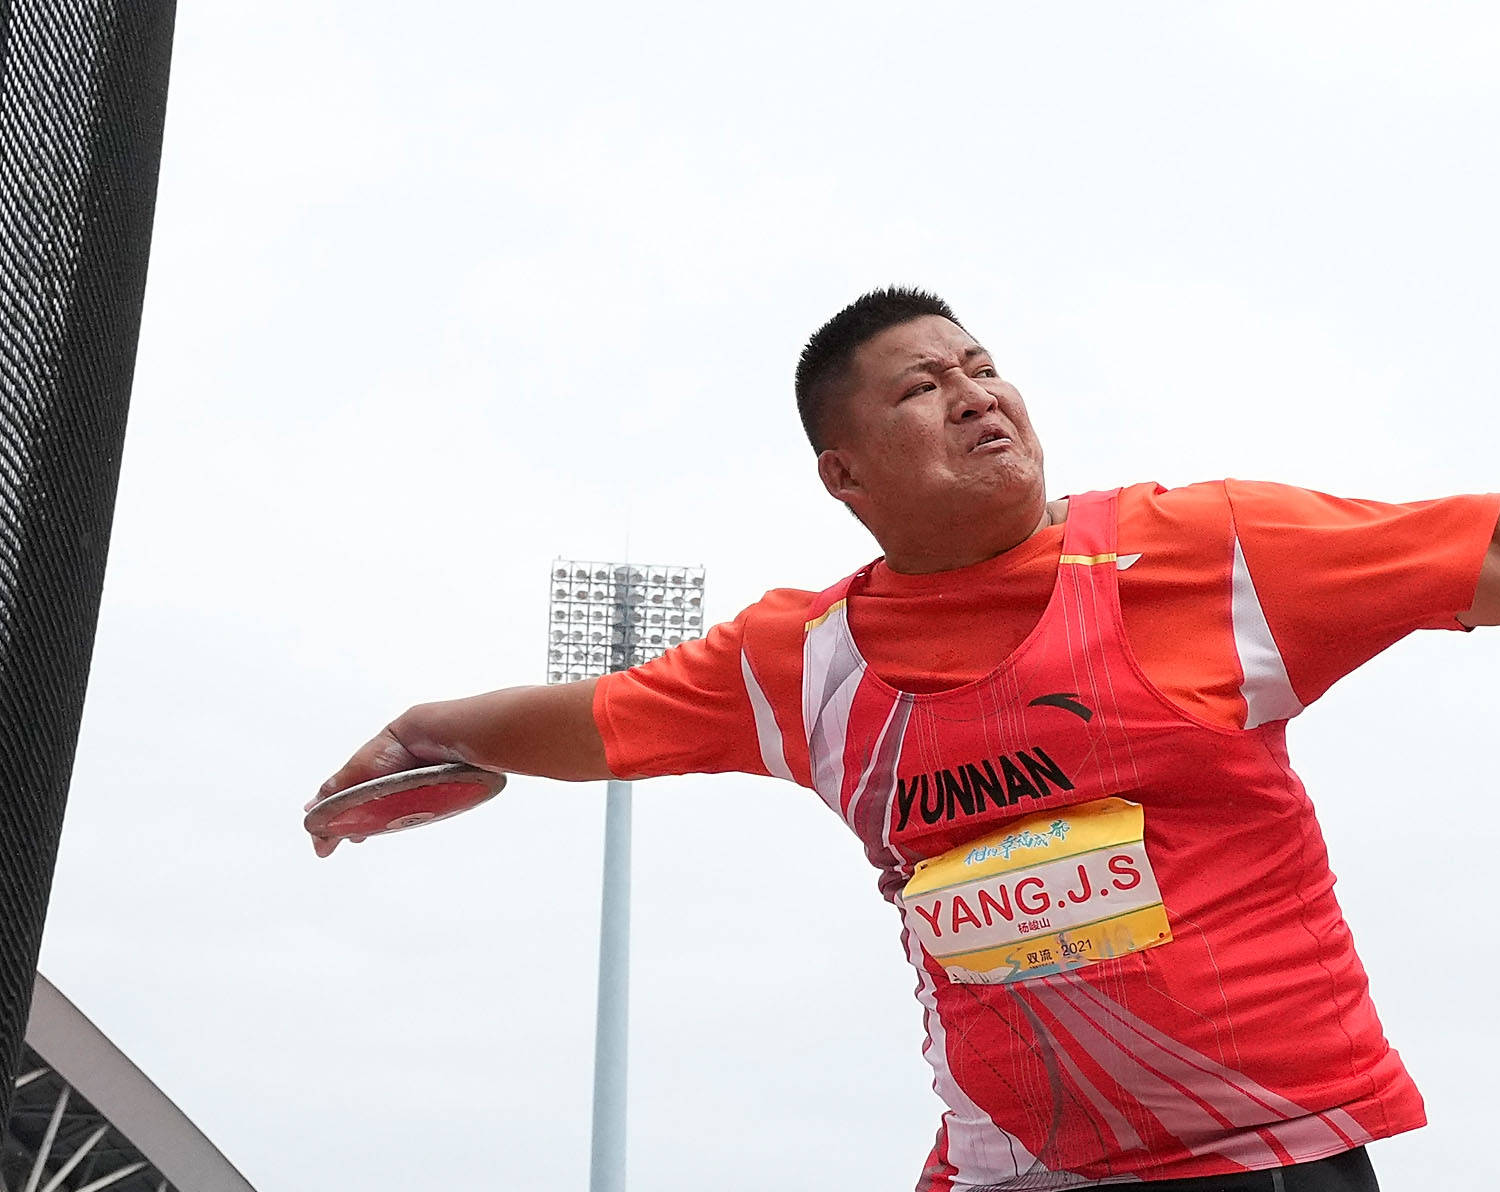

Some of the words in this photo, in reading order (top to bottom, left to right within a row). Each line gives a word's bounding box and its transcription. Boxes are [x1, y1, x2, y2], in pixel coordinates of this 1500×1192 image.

[896, 747, 1075, 832] YUNNAN
[915, 855, 1141, 938] YANG.J.S
[1018, 918, 1051, 934] 杨峻山
